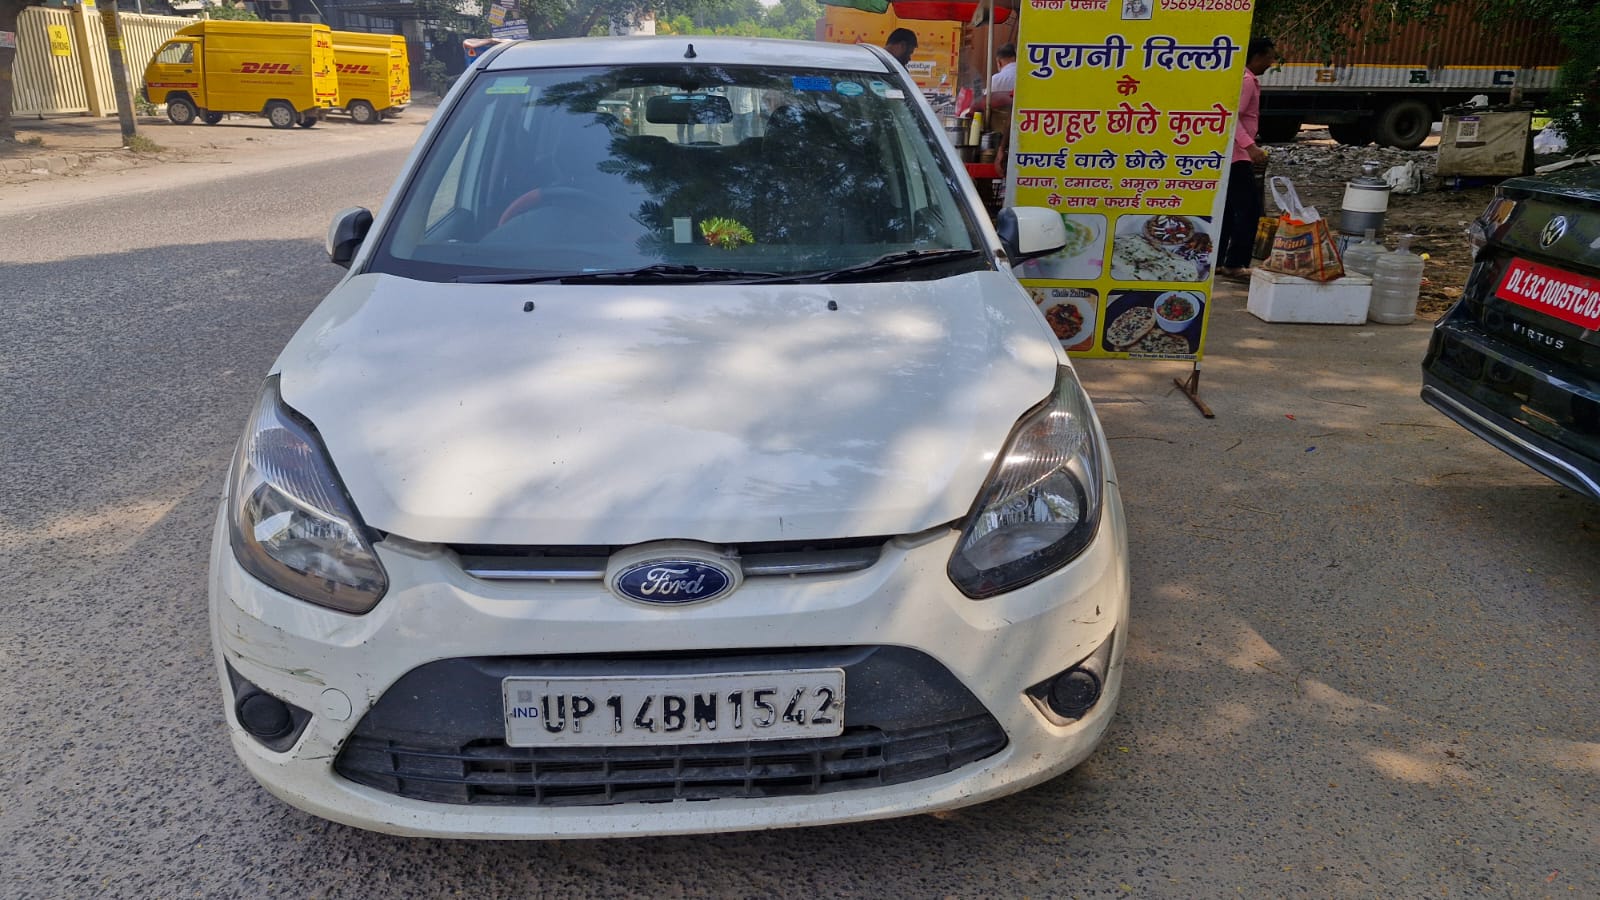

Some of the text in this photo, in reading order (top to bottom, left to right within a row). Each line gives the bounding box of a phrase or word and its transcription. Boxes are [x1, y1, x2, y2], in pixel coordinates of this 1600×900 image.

[1160, 0, 1251, 10] 9569426806
[52, 41, 69, 50] PARKING
[1028, 35, 1240, 78] पुरानी दिल्ली
[240, 62, 293, 75] DHL
[335, 63, 371, 75] DHL
[1117, 75, 1140, 97] के
[1492, 70, 1515, 86] C
[1019, 102, 1232, 145] मशहूर छोले कुल्चे
[1016, 148, 1225, 176] फराई वाले छोले कुल्चे
[1017, 177, 1218, 192] प्याज, टमाटर, अमूल मक्खन
[1048, 194, 1182, 208] के साथ फराई करके
[1505, 268, 1546, 300] DL13C
[1512, 322, 1564, 349] VIRTUS
[640, 568, 705, 595] Ford
[513, 707, 538, 718] IND
